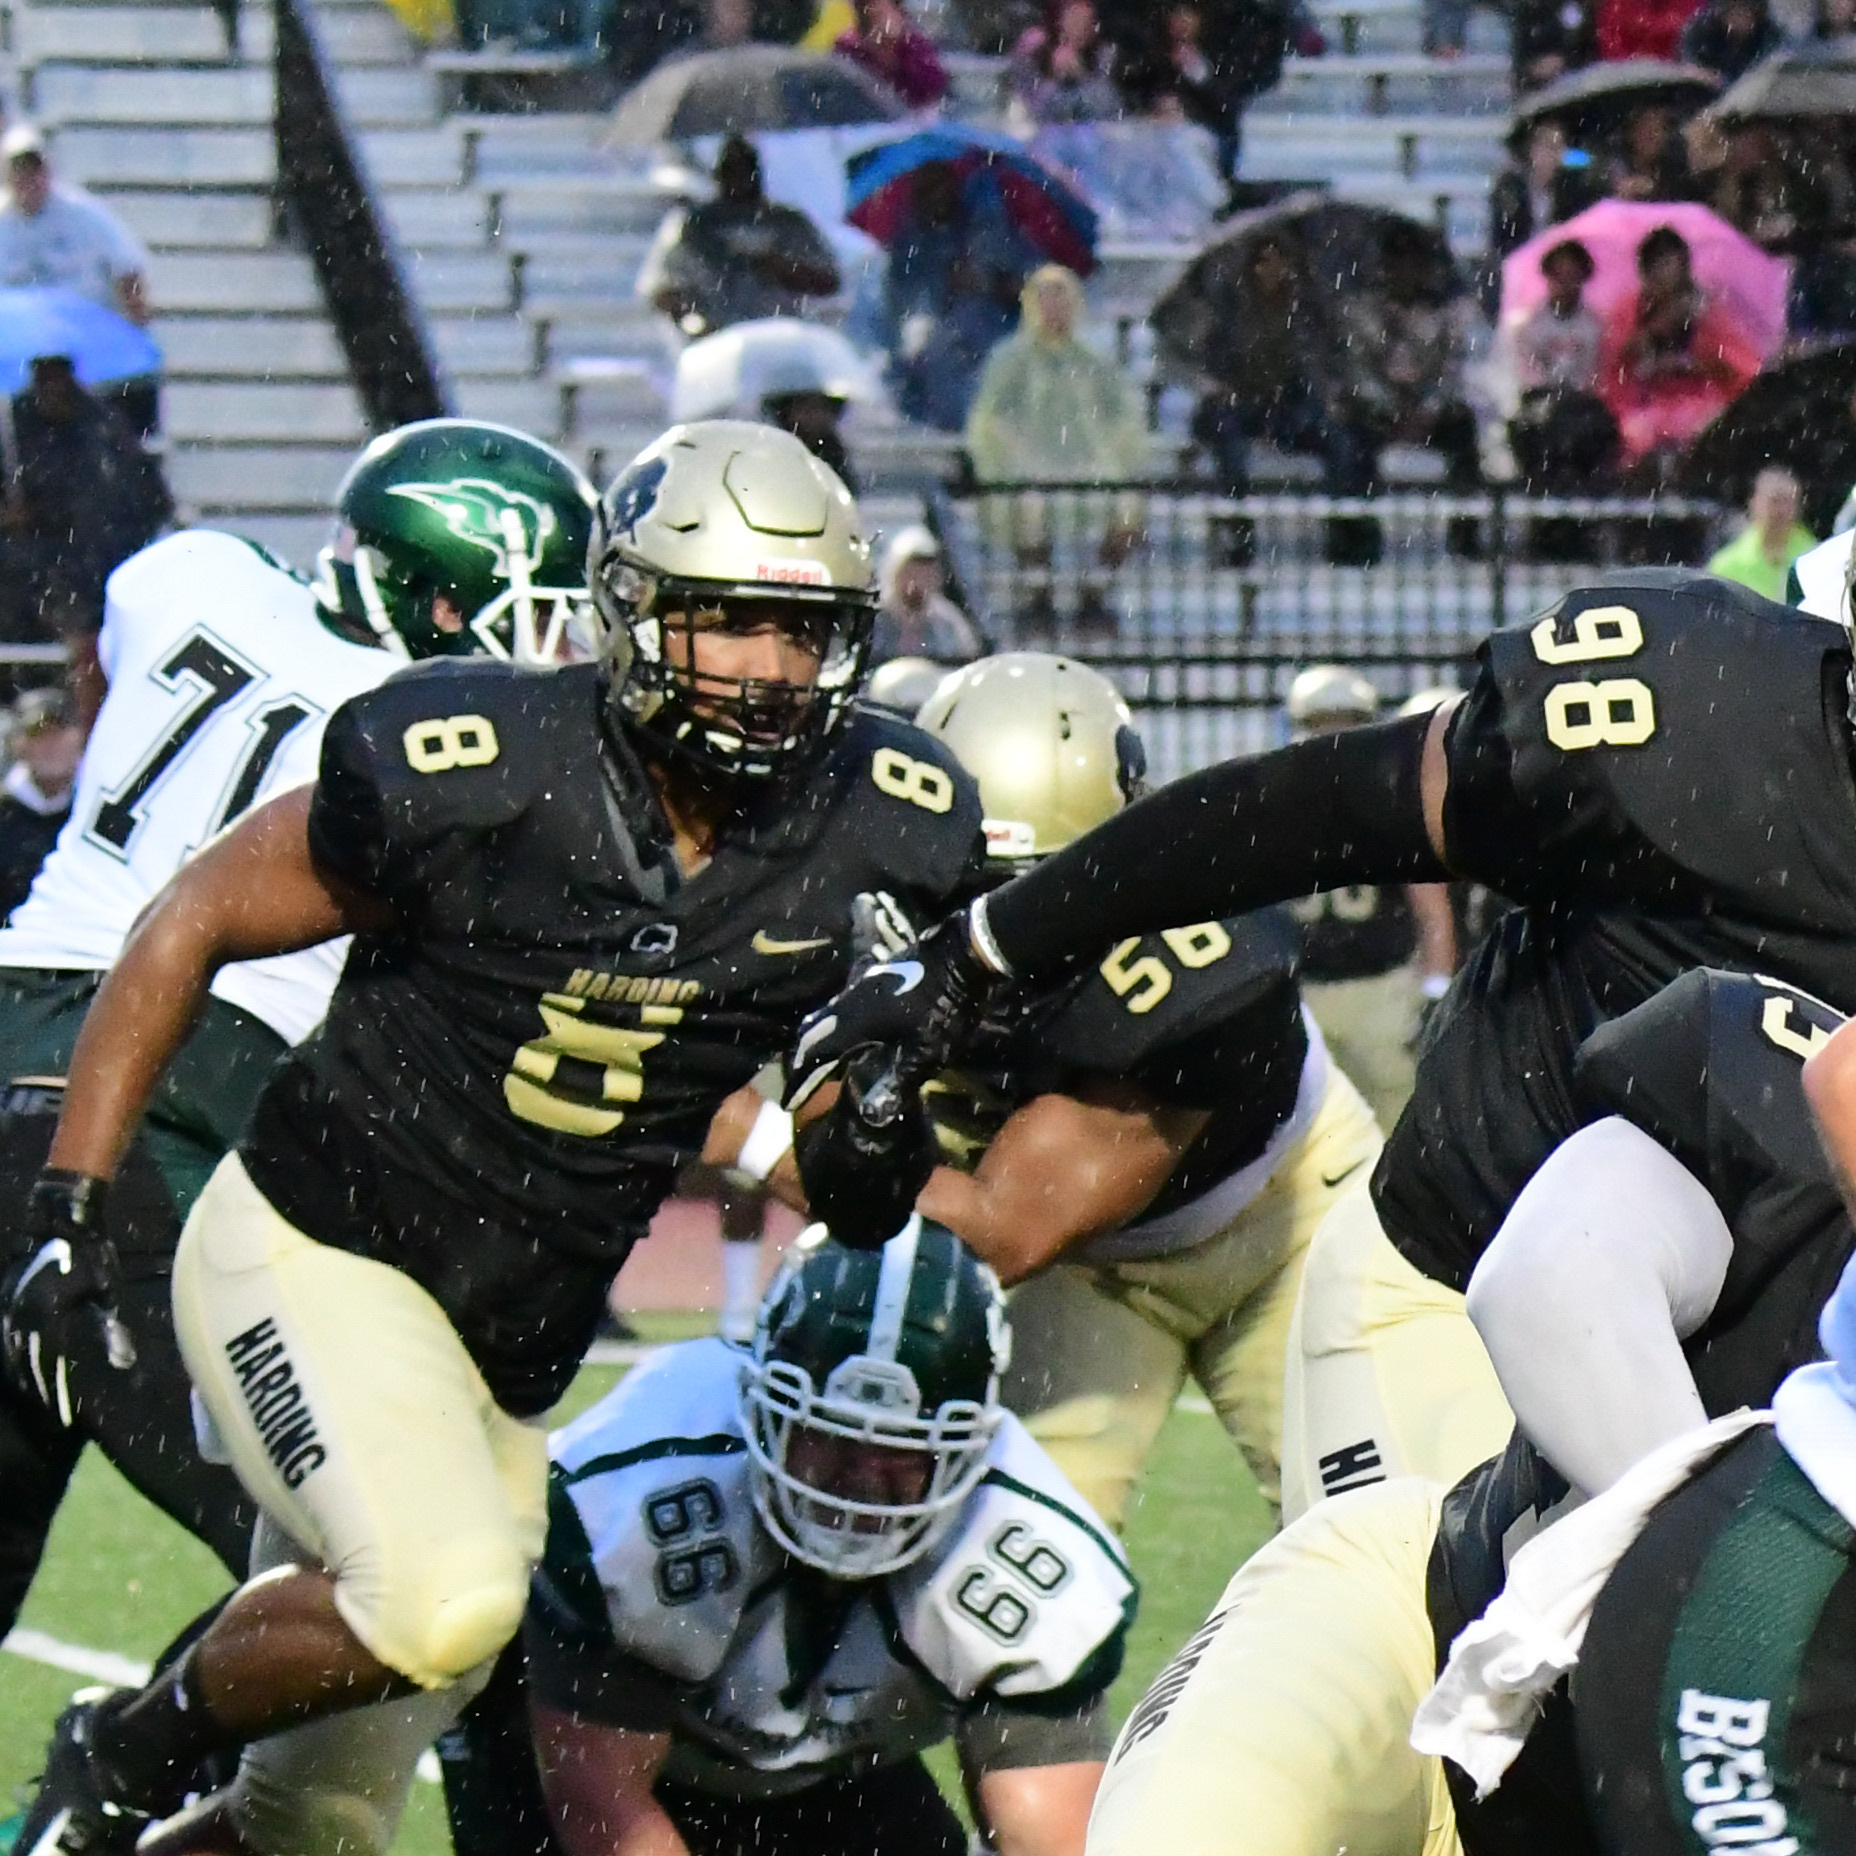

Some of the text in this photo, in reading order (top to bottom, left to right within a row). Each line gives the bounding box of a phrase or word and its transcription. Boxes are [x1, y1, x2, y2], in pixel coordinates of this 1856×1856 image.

[404, 713, 499, 774] 8
[1531, 606, 1655, 752] 98
[82, 624, 327, 866] 71
[871, 746, 954, 814] 8
[564, 969, 701, 1005] HARDING
[502, 992, 685, 1138] 8
[225, 1317, 326, 1490] HARDING
[641, 1478, 740, 1608] 66
[955, 1518, 1077, 1649] 66
